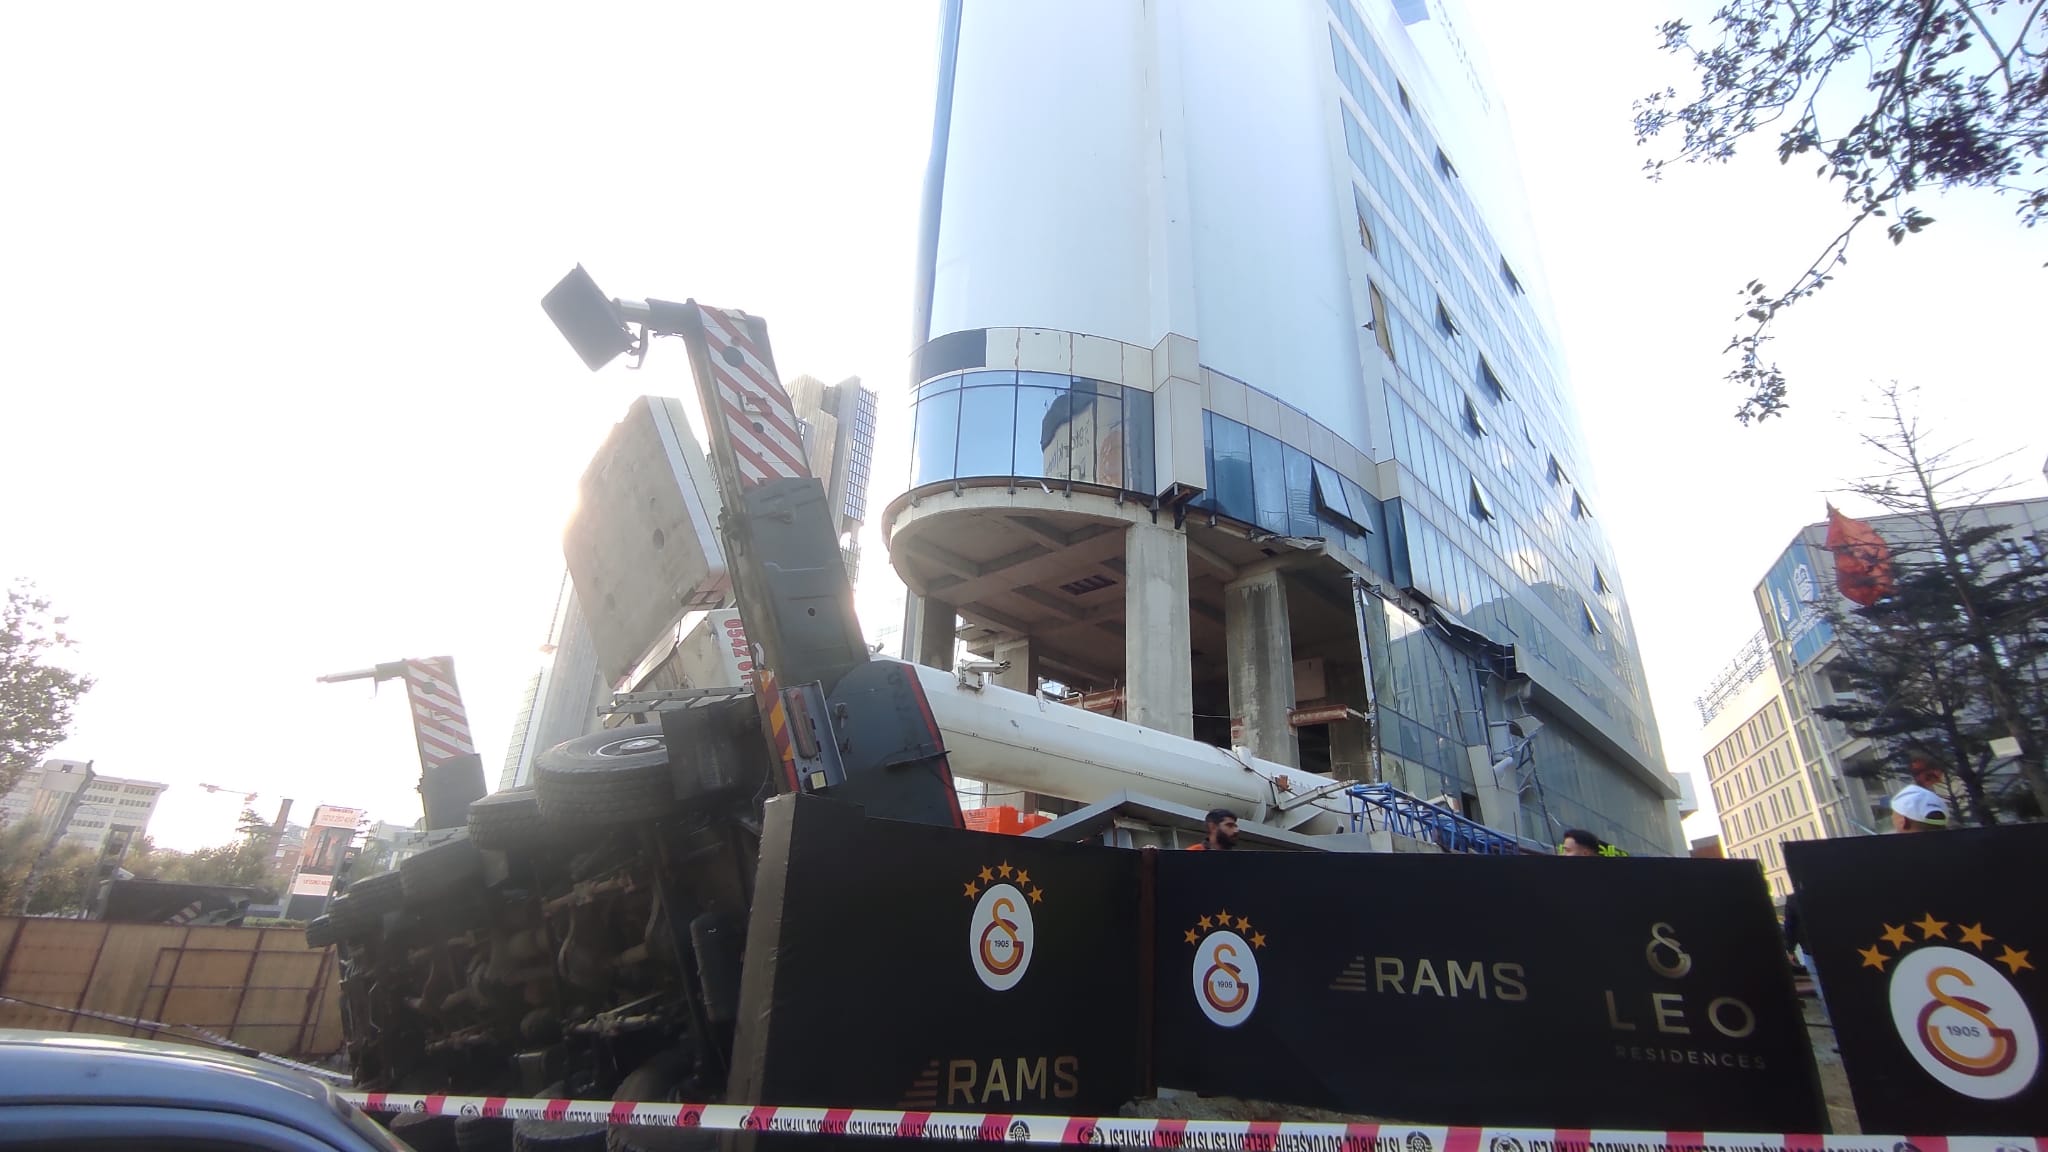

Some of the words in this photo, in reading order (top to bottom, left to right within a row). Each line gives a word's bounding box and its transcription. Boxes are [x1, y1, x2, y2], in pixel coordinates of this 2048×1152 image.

[994, 939, 1010, 948] 1905
[1217, 980, 1233, 989] 1905
[1375, 956, 1528, 1003] RAMS
[1604, 990, 1757, 1039] LEO
[1946, 1025, 1981, 1038] 1905
[1615, 1045, 1767, 1071] RESIDENCES
[947, 1055, 1080, 1105] RAMS
